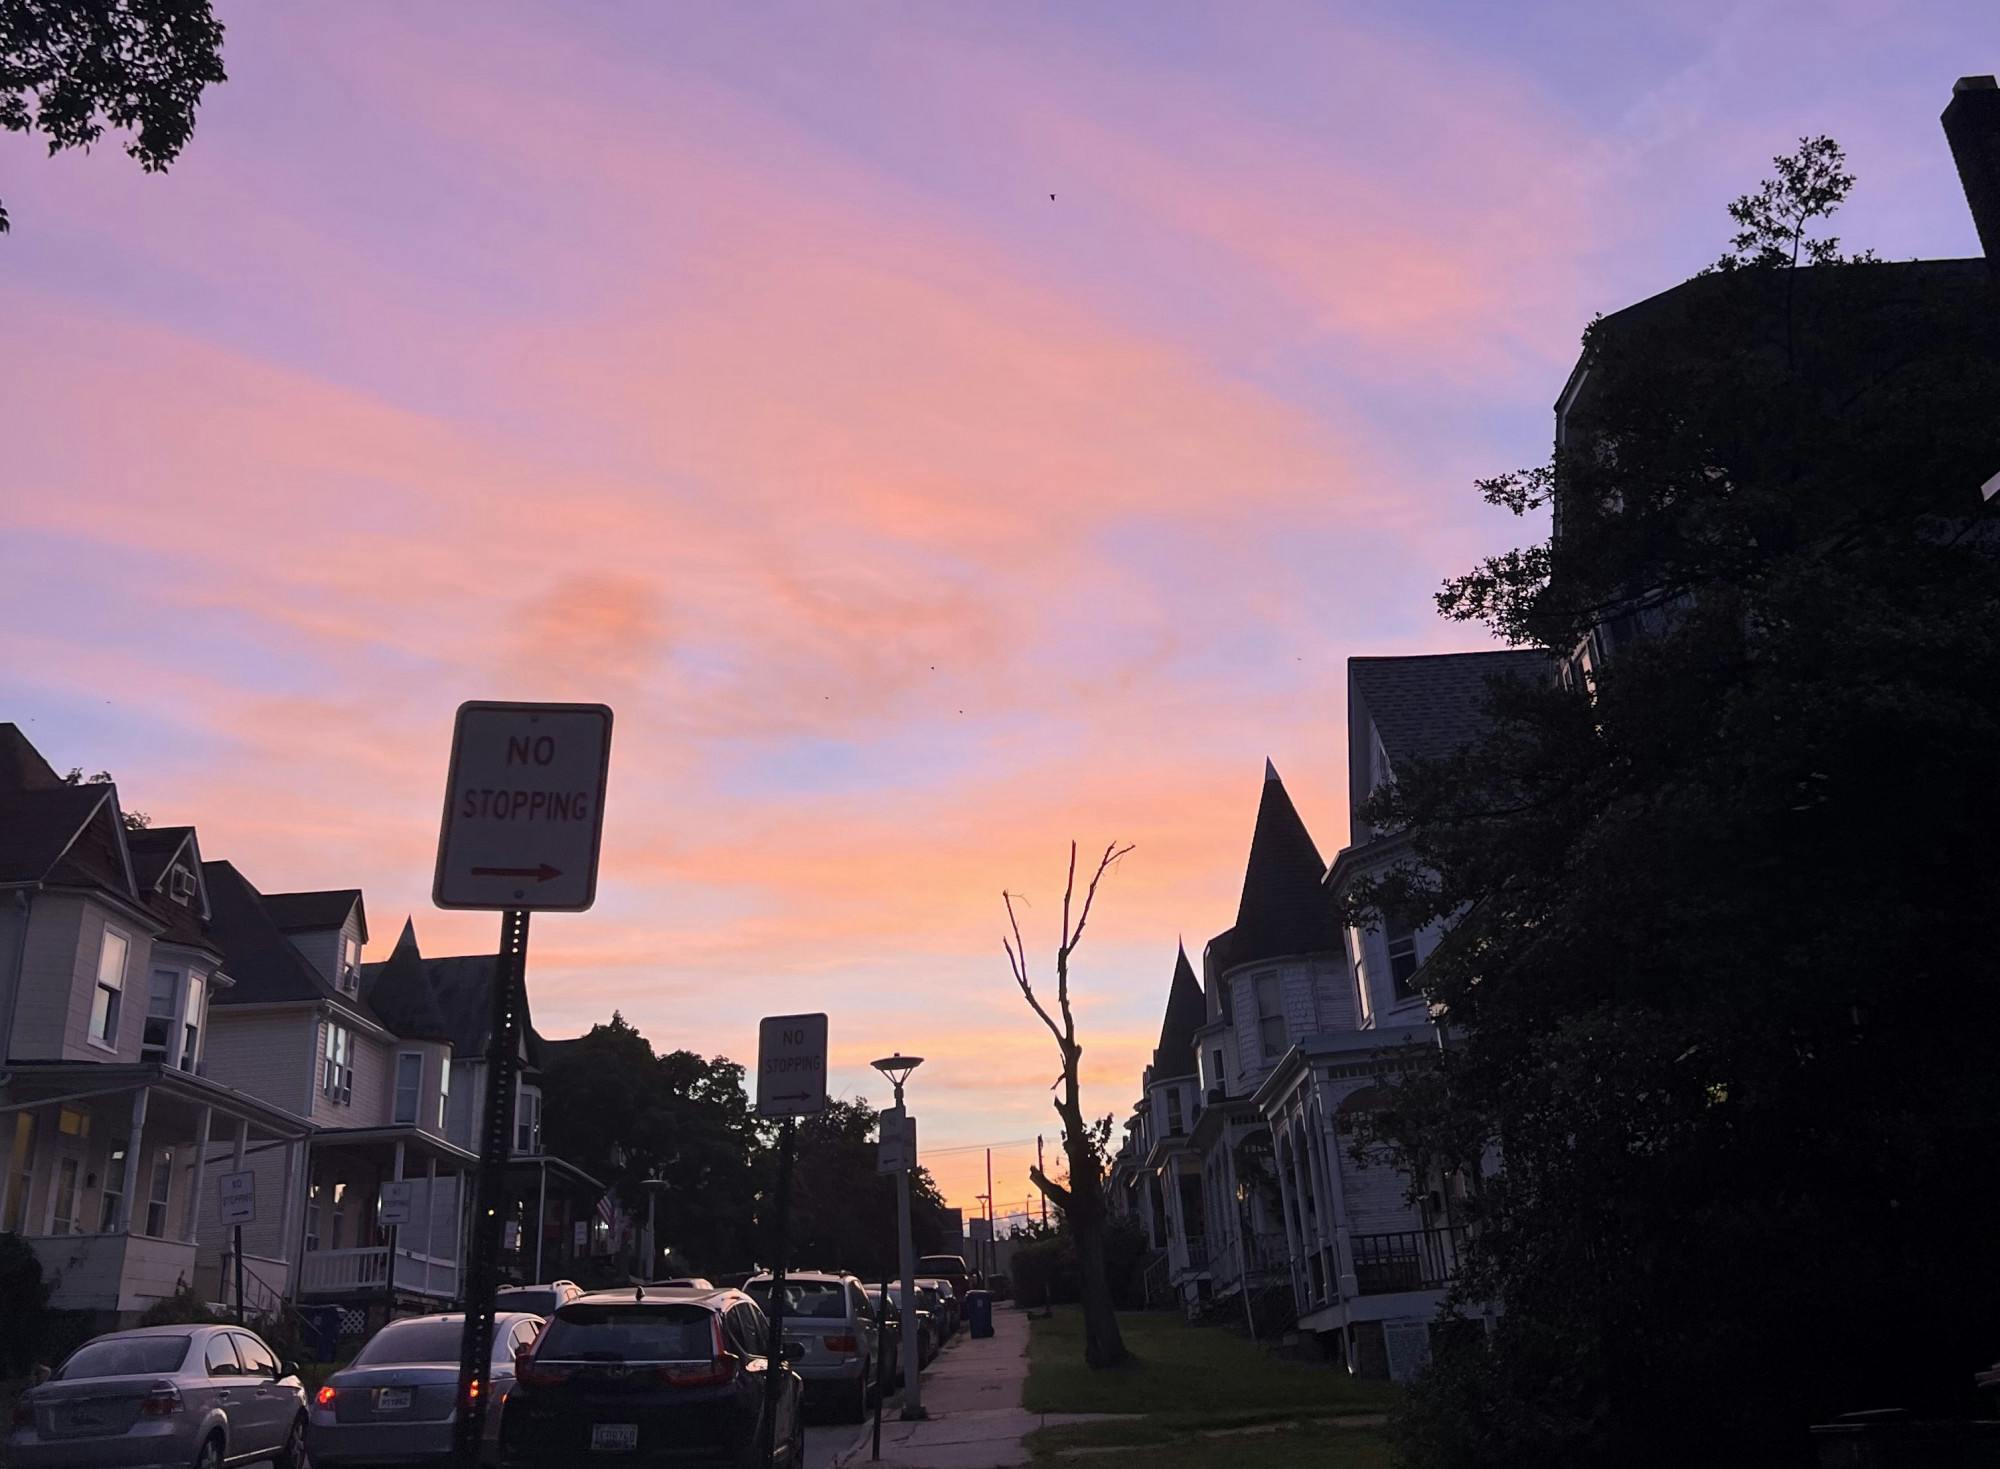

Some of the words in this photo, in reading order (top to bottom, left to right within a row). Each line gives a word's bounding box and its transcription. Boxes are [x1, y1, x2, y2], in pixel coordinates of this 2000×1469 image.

[506, 736, 556, 767] NO
[462, 789, 588, 822] STOPPING
[783, 1030, 804, 1046] NO
[766, 1055, 821, 1074] STOPPING
